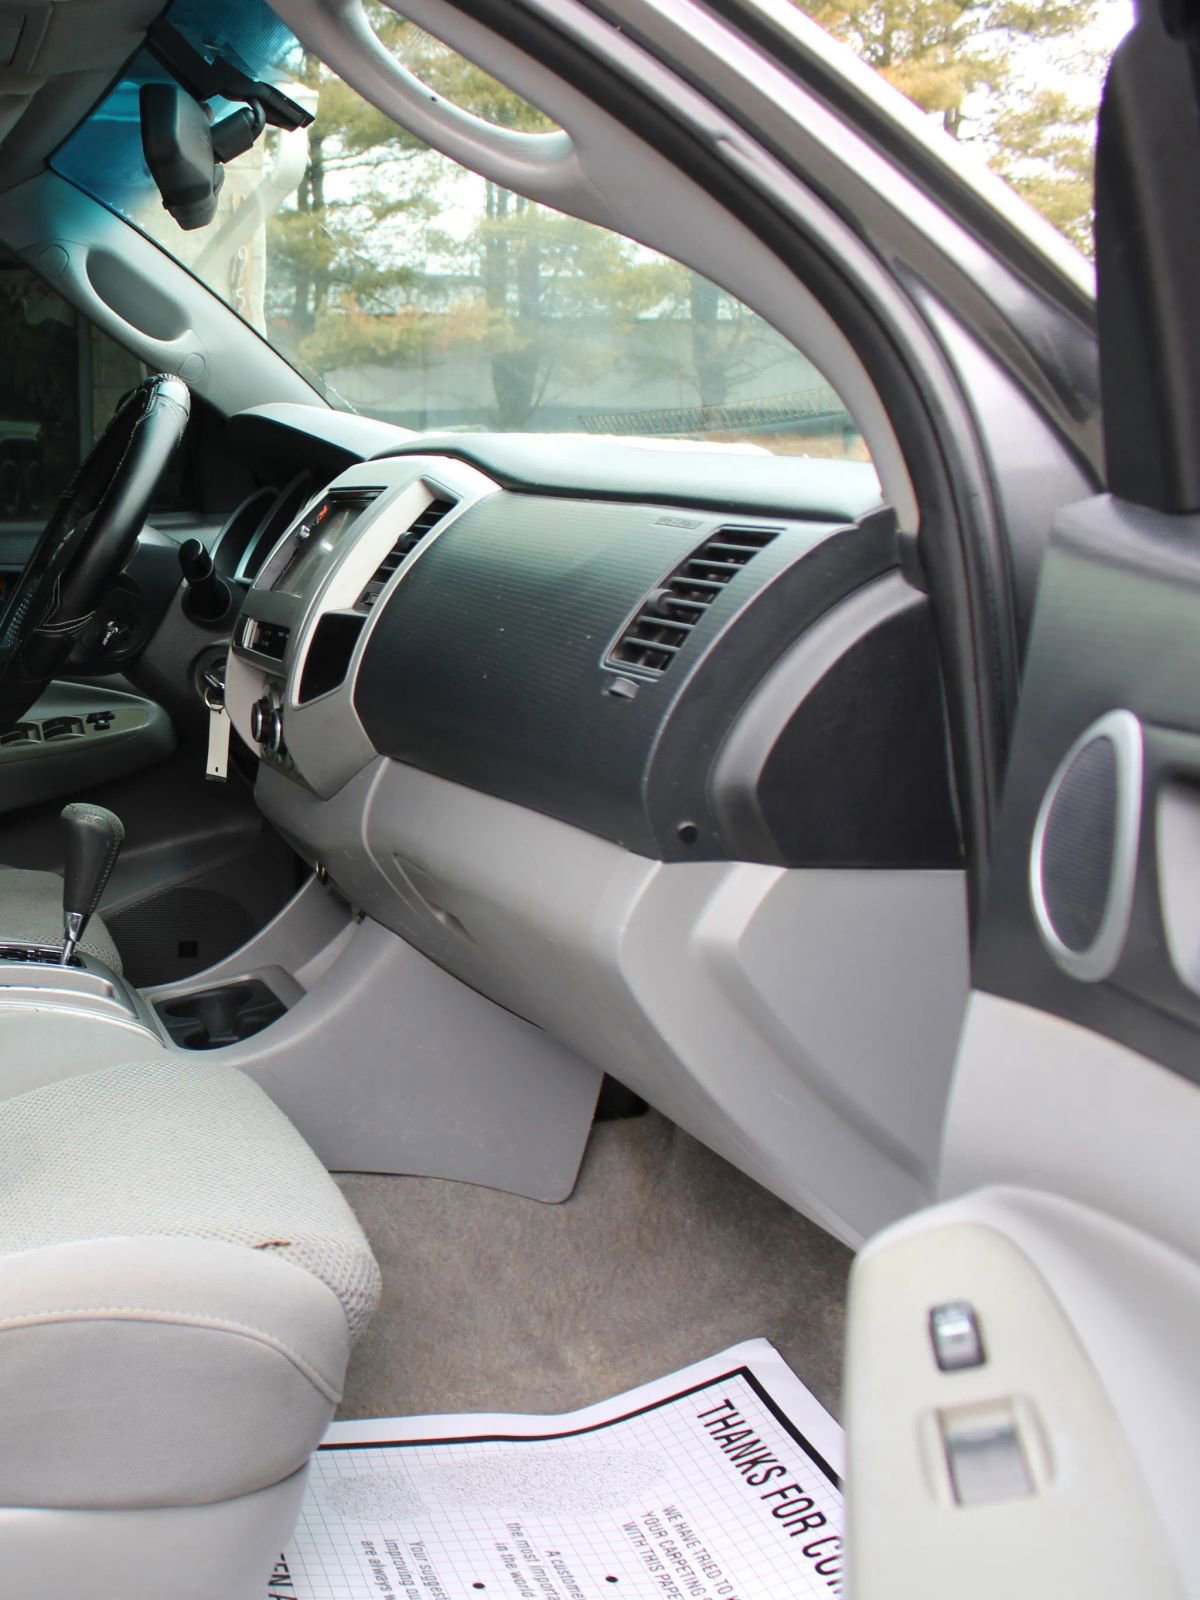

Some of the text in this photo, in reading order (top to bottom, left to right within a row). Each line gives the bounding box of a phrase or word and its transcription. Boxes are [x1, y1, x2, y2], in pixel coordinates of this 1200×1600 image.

[697, 1398, 787, 1486] THANKS
[760, 1483, 827, 1538] FOR
[361, 1540, 377, 1556] are
[408, 1540, 428, 1562] Your
[506, 1522, 523, 1538] the
[516, 1539, 540, 1562] most
[622, 1521, 648, 1548] WITH
[640, 1548, 665, 1572] THIS
[641, 1510, 707, 1597] YOUR CARPETING
[662, 1505, 683, 1522] WE
[673, 1521, 701, 1549] HAVE
[693, 1547, 722, 1579] TRIED
[714, 1578, 733, 1595] TO
[368, 1558, 393, 1593] always
[500, 1553, 518, 1569] the
[510, 1571, 537, 1598] world
[550, 1559, 586, 1600] custome
